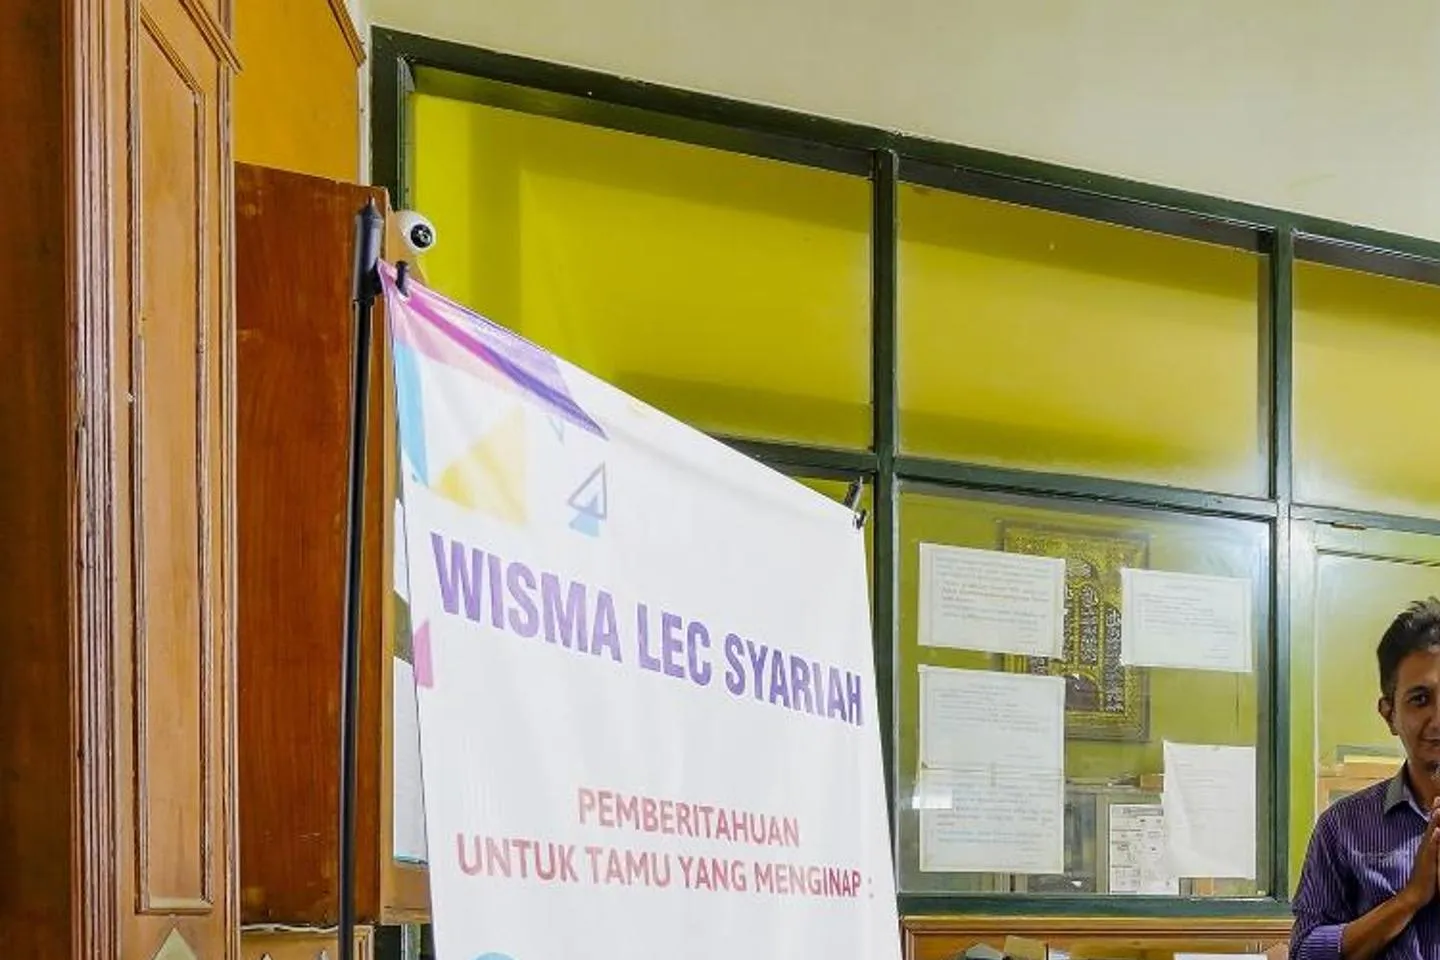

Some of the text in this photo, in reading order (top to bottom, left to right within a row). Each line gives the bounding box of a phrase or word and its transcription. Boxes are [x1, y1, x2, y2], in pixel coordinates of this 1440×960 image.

[430, 532, 862, 726] WISMA LEC SYARIAH
[578, 788, 799, 847] PEMBERITAHUAN
[457, 833, 578, 882] UNTUK
[585, 846, 671, 888] TAMU
[679, 855, 747, 892] YANG
[755, 862, 861, 897] MENGINAP
